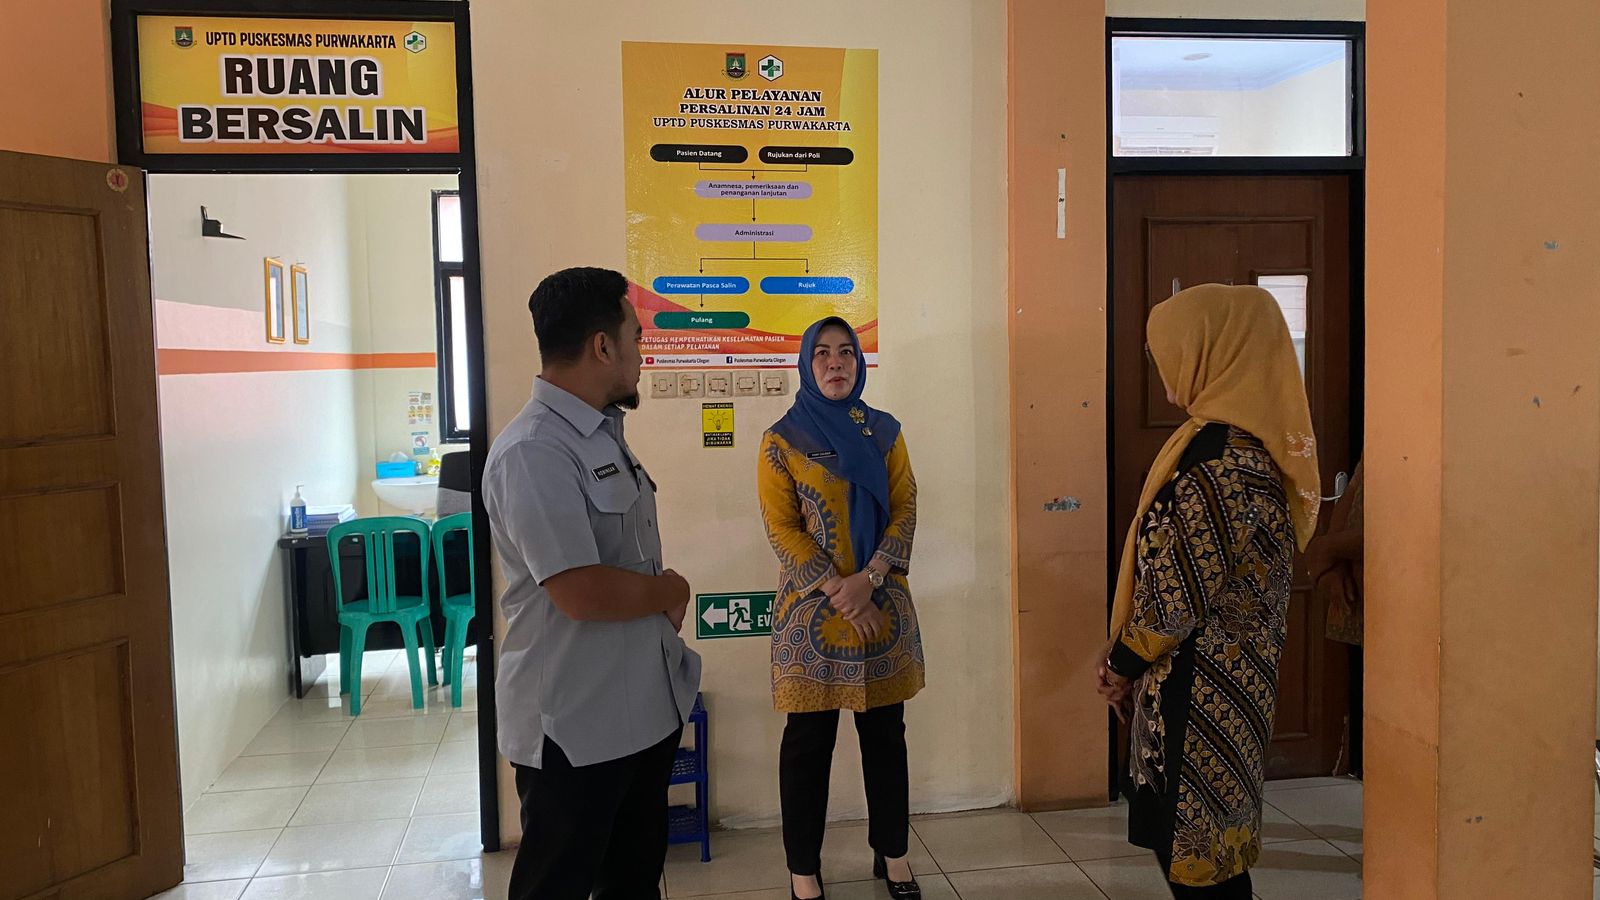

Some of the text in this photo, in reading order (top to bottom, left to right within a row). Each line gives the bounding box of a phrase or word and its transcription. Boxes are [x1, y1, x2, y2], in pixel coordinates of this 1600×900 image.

[205, 31, 396, 49] UPTD PUSKESMAS PURWAKARTA
[223, 56, 379, 96] RUANG
[684, 88, 822, 102] ALUR PELAYANAN
[679, 104, 826, 117] PERSALINAN 24 JAM
[180, 106, 425, 142] BERSALIN
[653, 118, 852, 131] UPTD PUSKESMAS PURWAKARTA
[676, 149, 722, 158] Pasien Datang
[767, 151, 794, 159] Rujukan
[744, 183, 786, 191] pemeriksaan
[720, 189, 787, 197] penanganan lanjutan
[734, 229, 774, 237] Administrasi
[690, 316, 713, 324] Pulang
